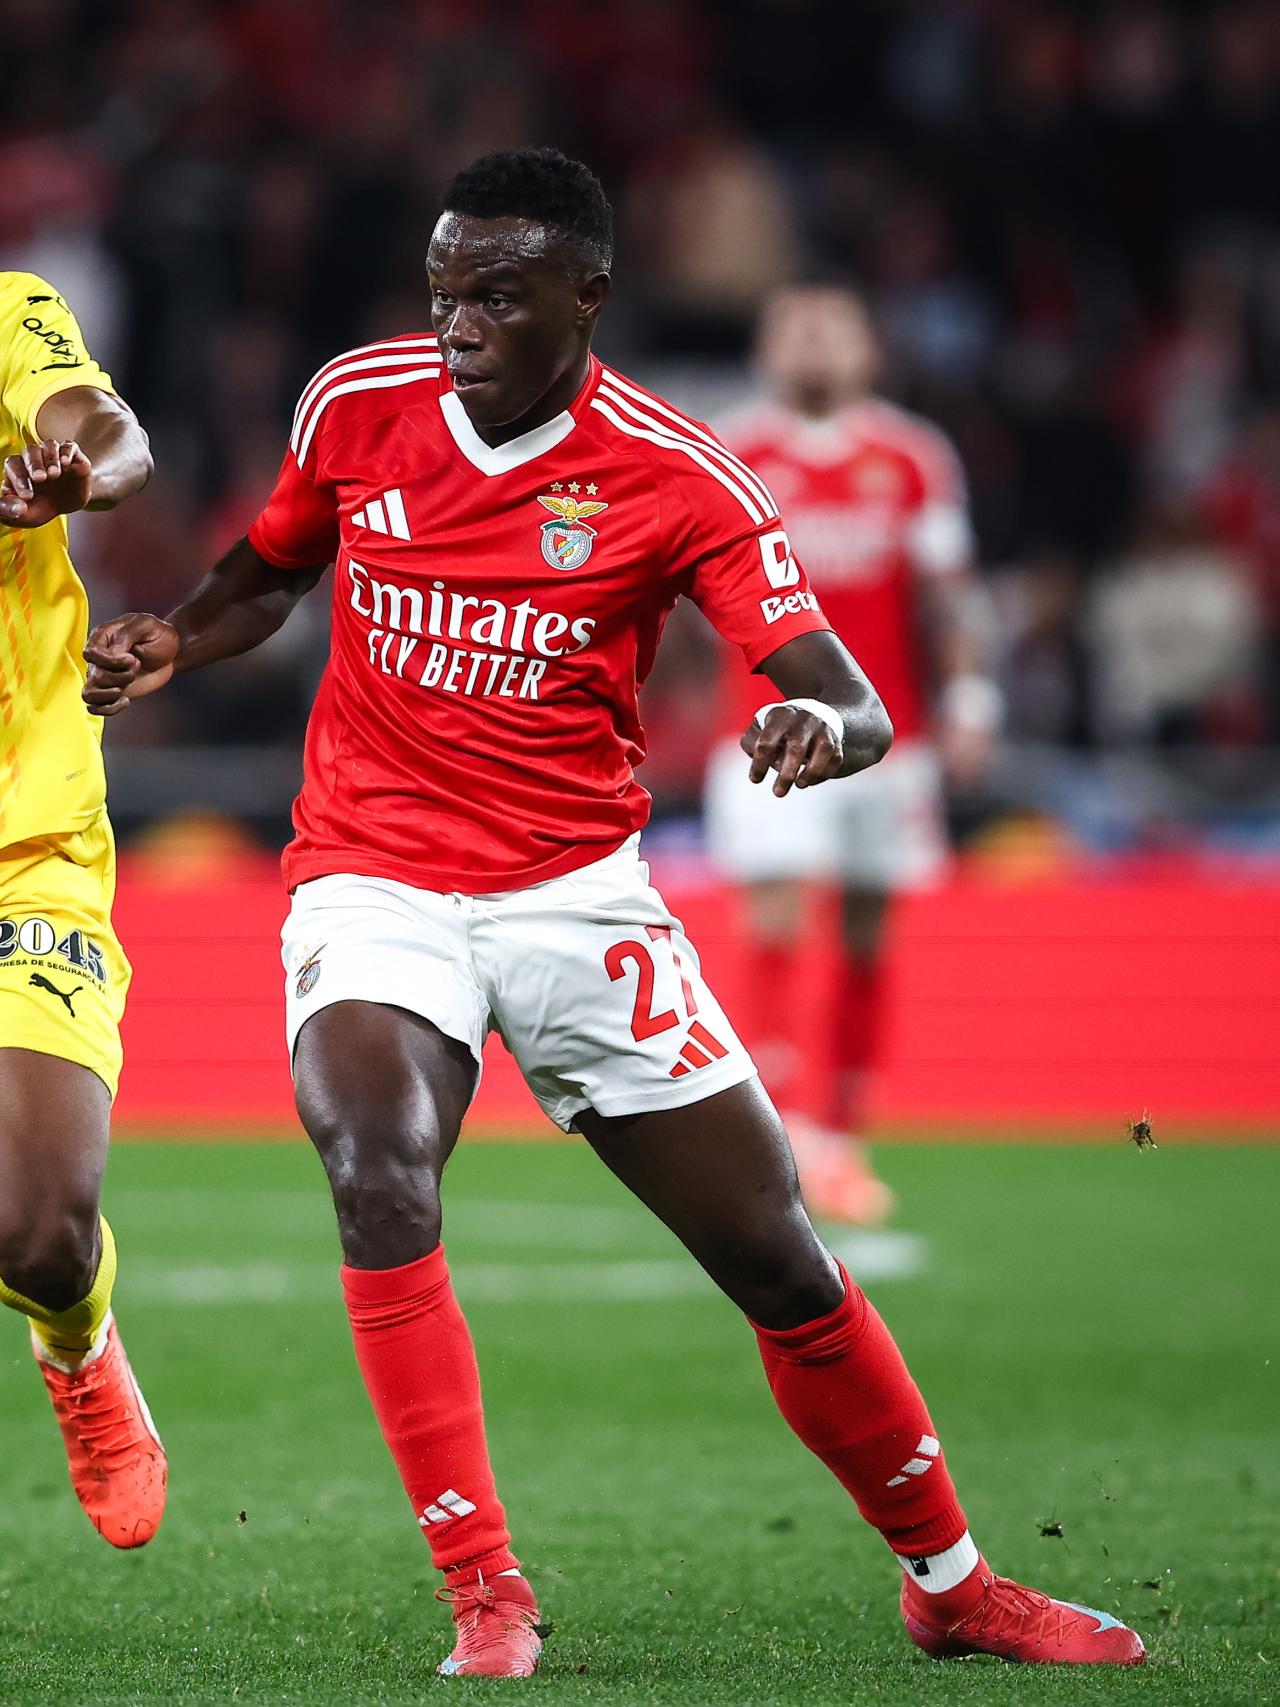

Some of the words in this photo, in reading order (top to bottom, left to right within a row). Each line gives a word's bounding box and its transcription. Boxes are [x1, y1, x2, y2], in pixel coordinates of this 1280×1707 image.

[348, 558, 597, 657] Emirates
[368, 628, 419, 678] FLY
[419, 643, 548, 700] BETTER
[31, 959, 44, 967] DE
[604, 924, 699, 1043] 27
